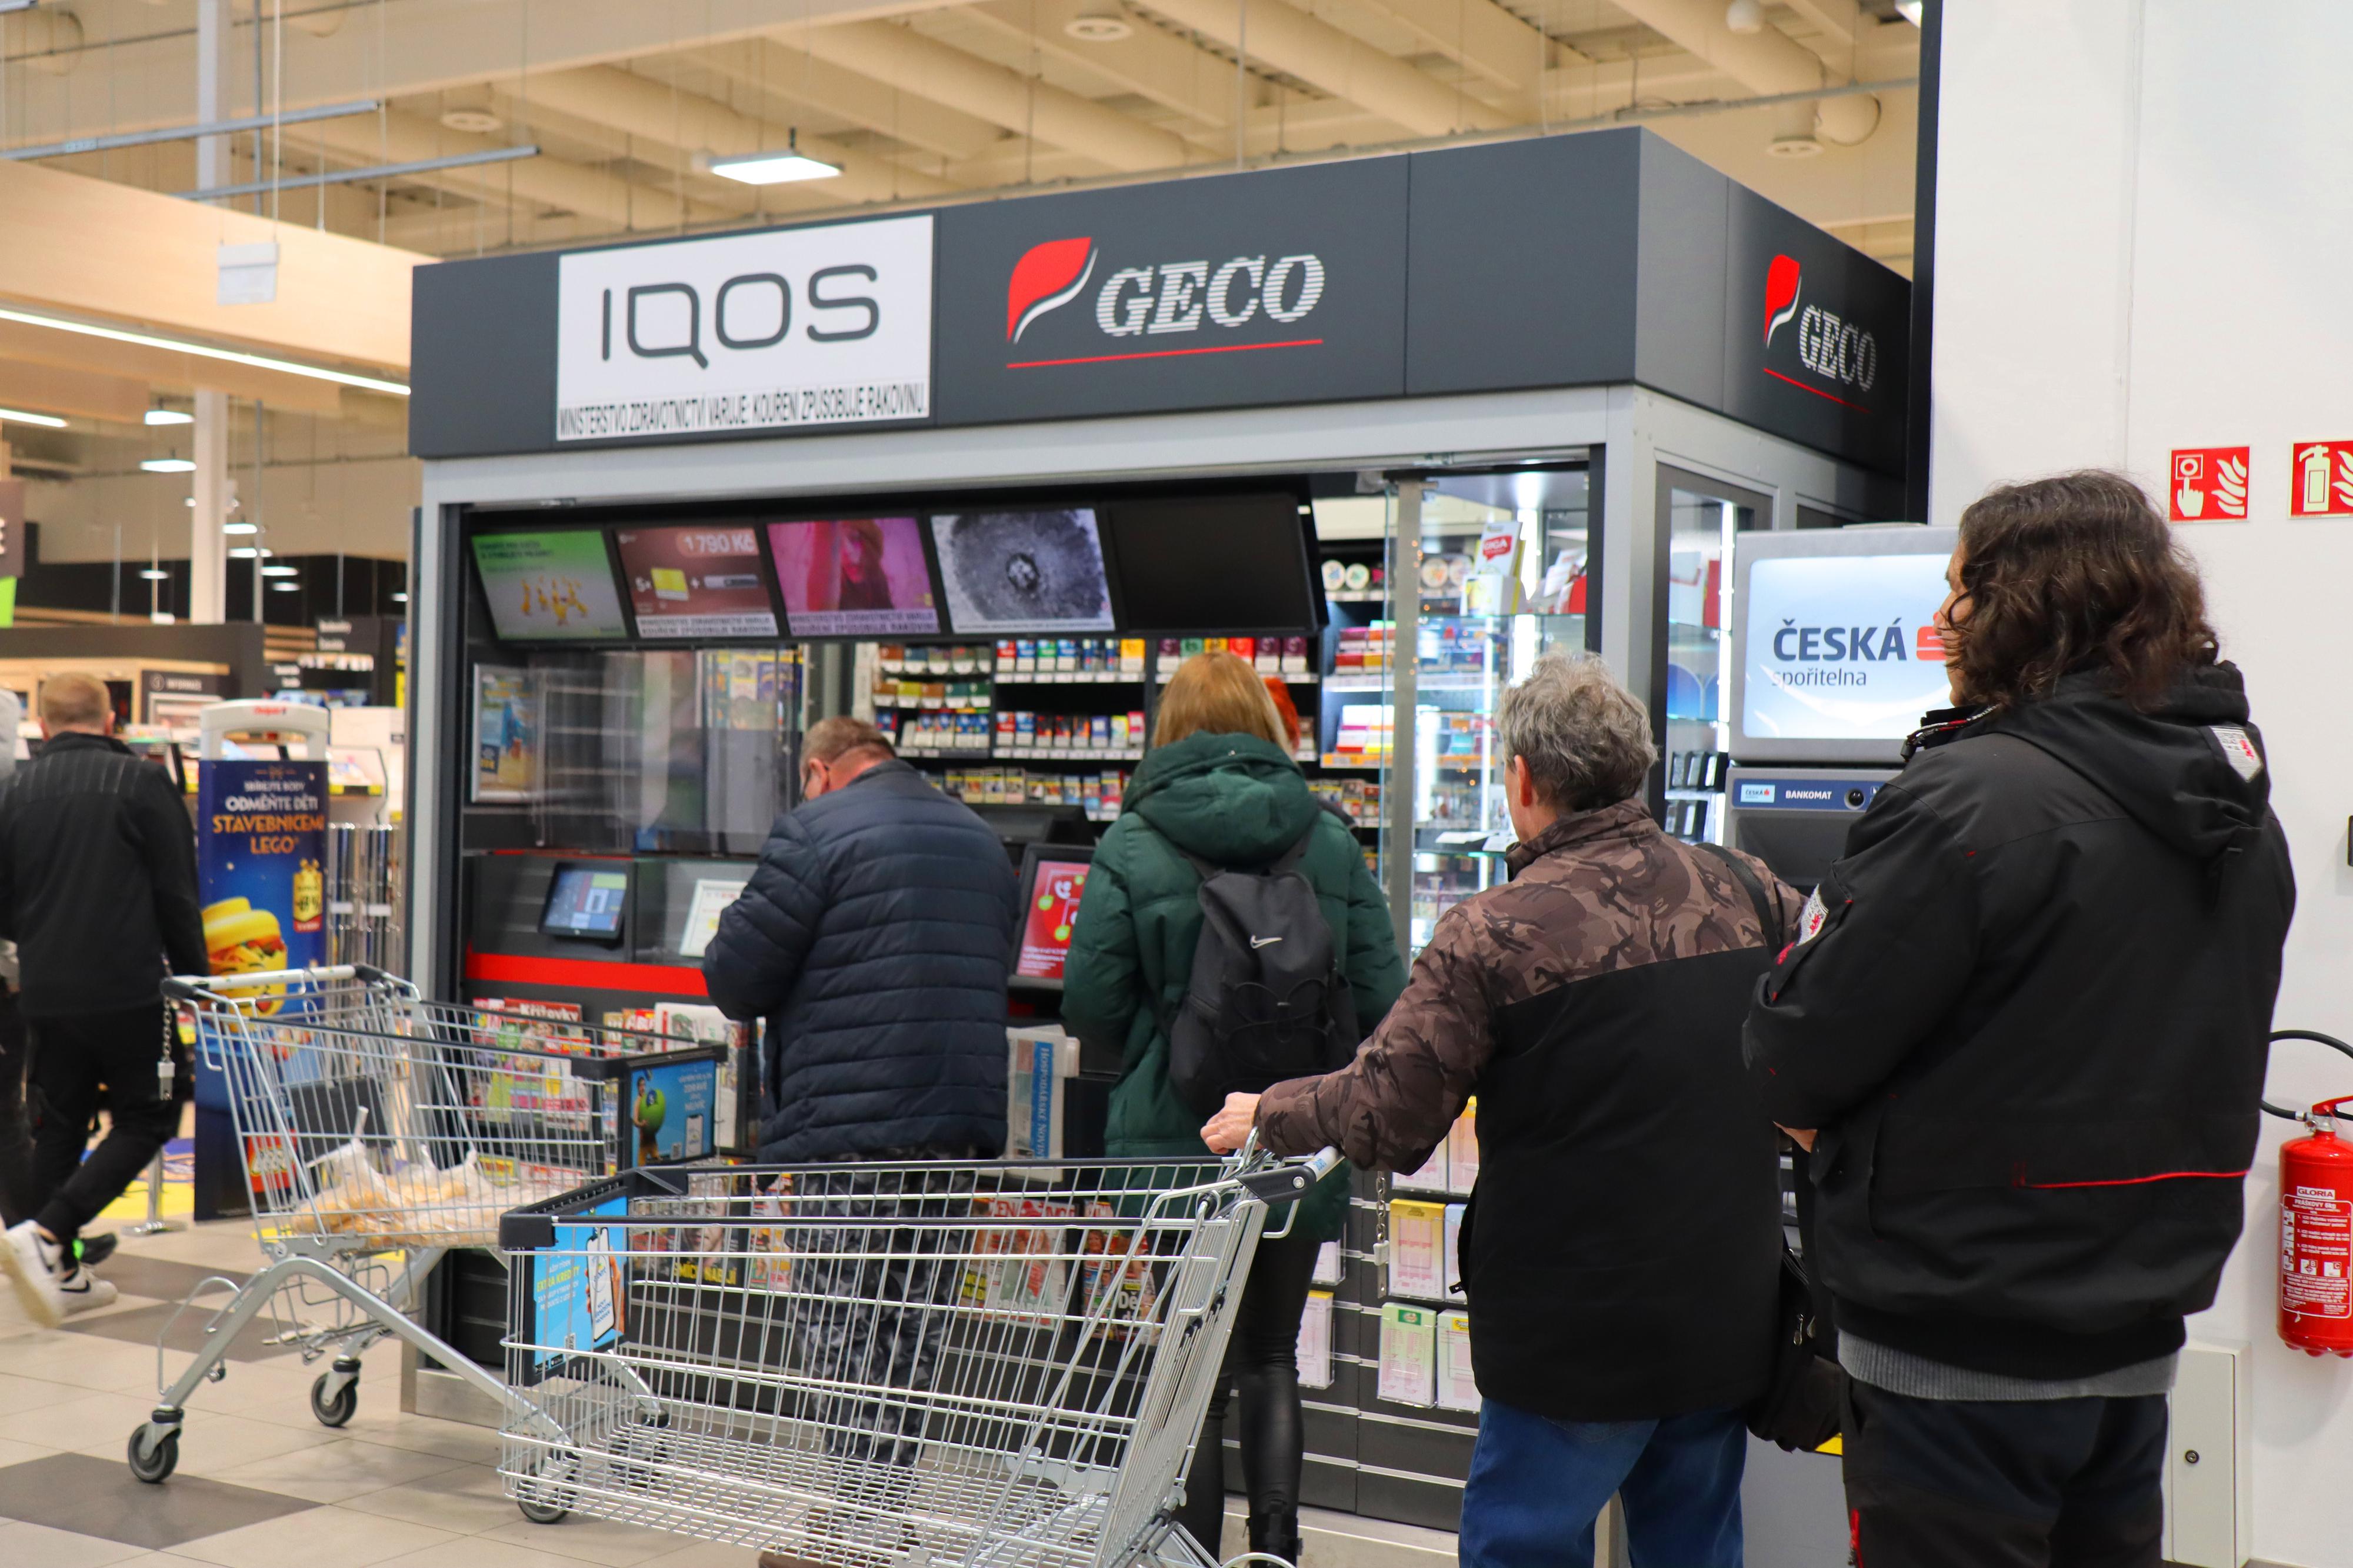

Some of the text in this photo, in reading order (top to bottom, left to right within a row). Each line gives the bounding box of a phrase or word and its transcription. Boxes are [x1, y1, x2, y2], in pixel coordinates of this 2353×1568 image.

[1095, 254, 1325, 336] GECO
[602, 264, 879, 369] IQOS
[1799, 303, 1877, 392] GECO
[1773, 618, 1907, 662] ČESKÁ
[1772, 668, 1867, 687] spořitelna
[1785, 790, 1832, 800] BANKOMAT
[212, 814, 325, 833] STAVEBNICEMI
[1036, 1123, 1048, 1158] NOVIN
[2298, 1189, 2333, 1197] GLORIA
[556, 1266, 580, 1284] KREDTY
